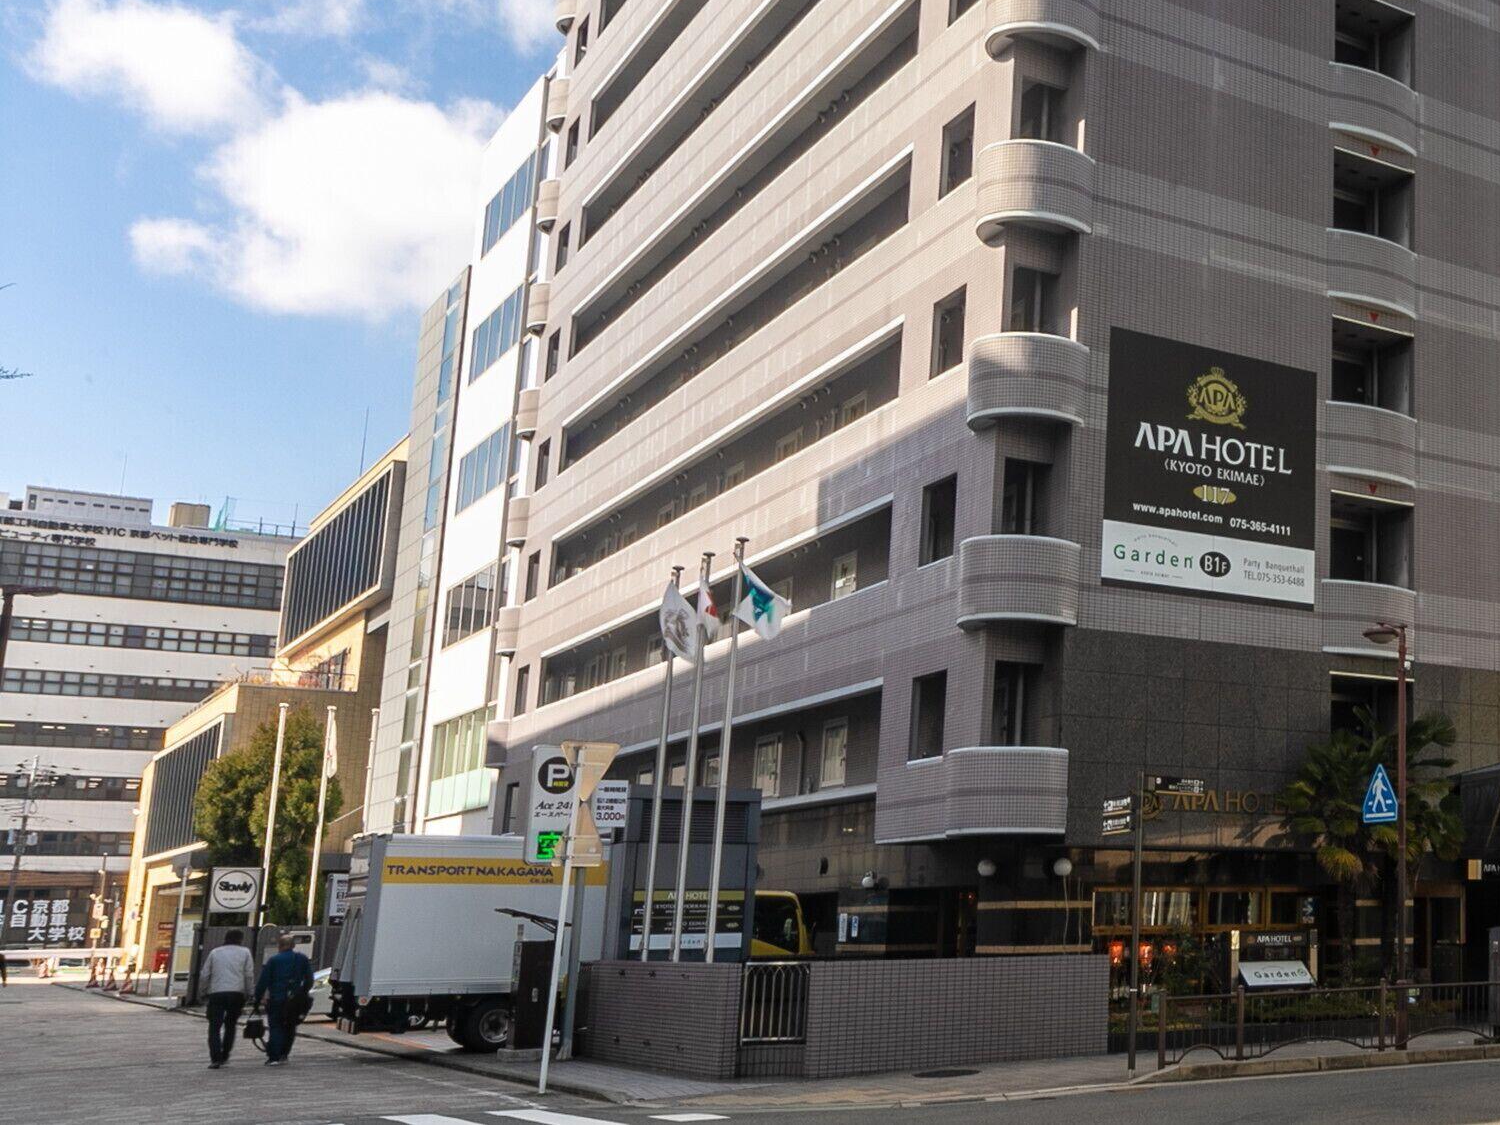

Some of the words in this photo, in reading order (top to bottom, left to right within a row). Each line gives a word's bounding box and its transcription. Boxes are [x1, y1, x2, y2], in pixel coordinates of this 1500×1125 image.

[1199, 386, 1236, 411] APA
[1134, 421, 1194, 457] APA
[1200, 433, 1292, 475] HOTEL
[1201, 484, 1231, 505] 117
[1132, 502, 1223, 523] www.apahotel.com
[1229, 517, 1291, 536] 075-365-4111
[1113, 544, 1193, 569] Garden
[1204, 555, 1228, 573] B1F
[1243, 557, 1260, 569] Party
[1265, 561, 1305, 573] Banquethall
[547, 764, 570, 787] P
[535, 801, 554, 809] Ace
[387, 865, 474, 875] TRANSPORT
[476, 867, 553, 876] NAKAGAWA
[27, 927, 86, 941] 大学校
[1257, 935, 1270, 943] APA
[1253, 970, 1298, 979] Garden
